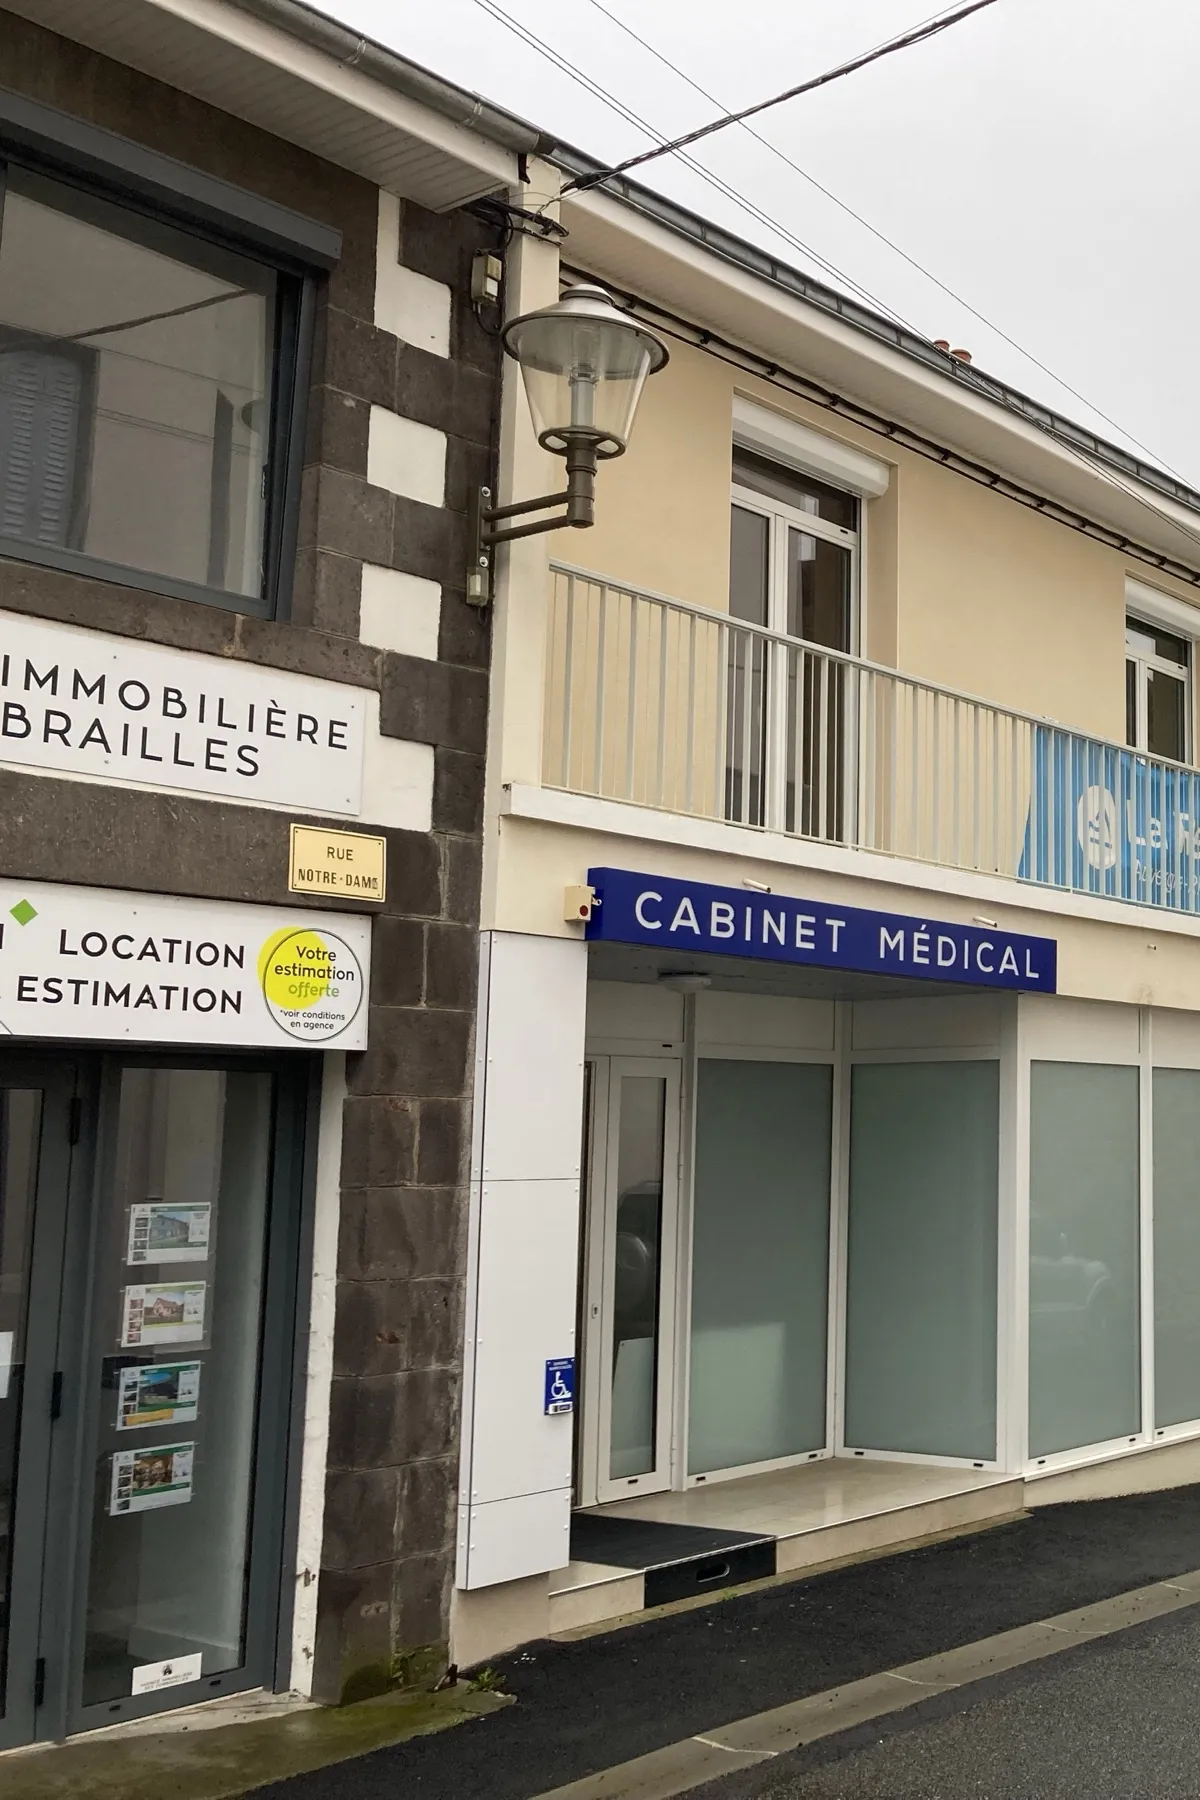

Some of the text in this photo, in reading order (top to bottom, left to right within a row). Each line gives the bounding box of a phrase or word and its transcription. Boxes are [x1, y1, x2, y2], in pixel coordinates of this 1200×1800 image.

[2, 654, 349, 750] IMMOBILIÈRE
[2, 701, 260, 777] BRAILLES
[327, 846, 354, 861] RUE
[634, 890, 1040, 980] CABINET MÉDICAL
[59, 929, 246, 969] LOCATION
[296, 945, 337, 962] Votre
[274, 963, 355, 982] estimation
[17, 975, 243, 1015] ESTIMATION
[288, 981, 340, 998] offerte
[302, 1011, 346, 1021] conditions
[303, 1021, 335, 1031] agence
